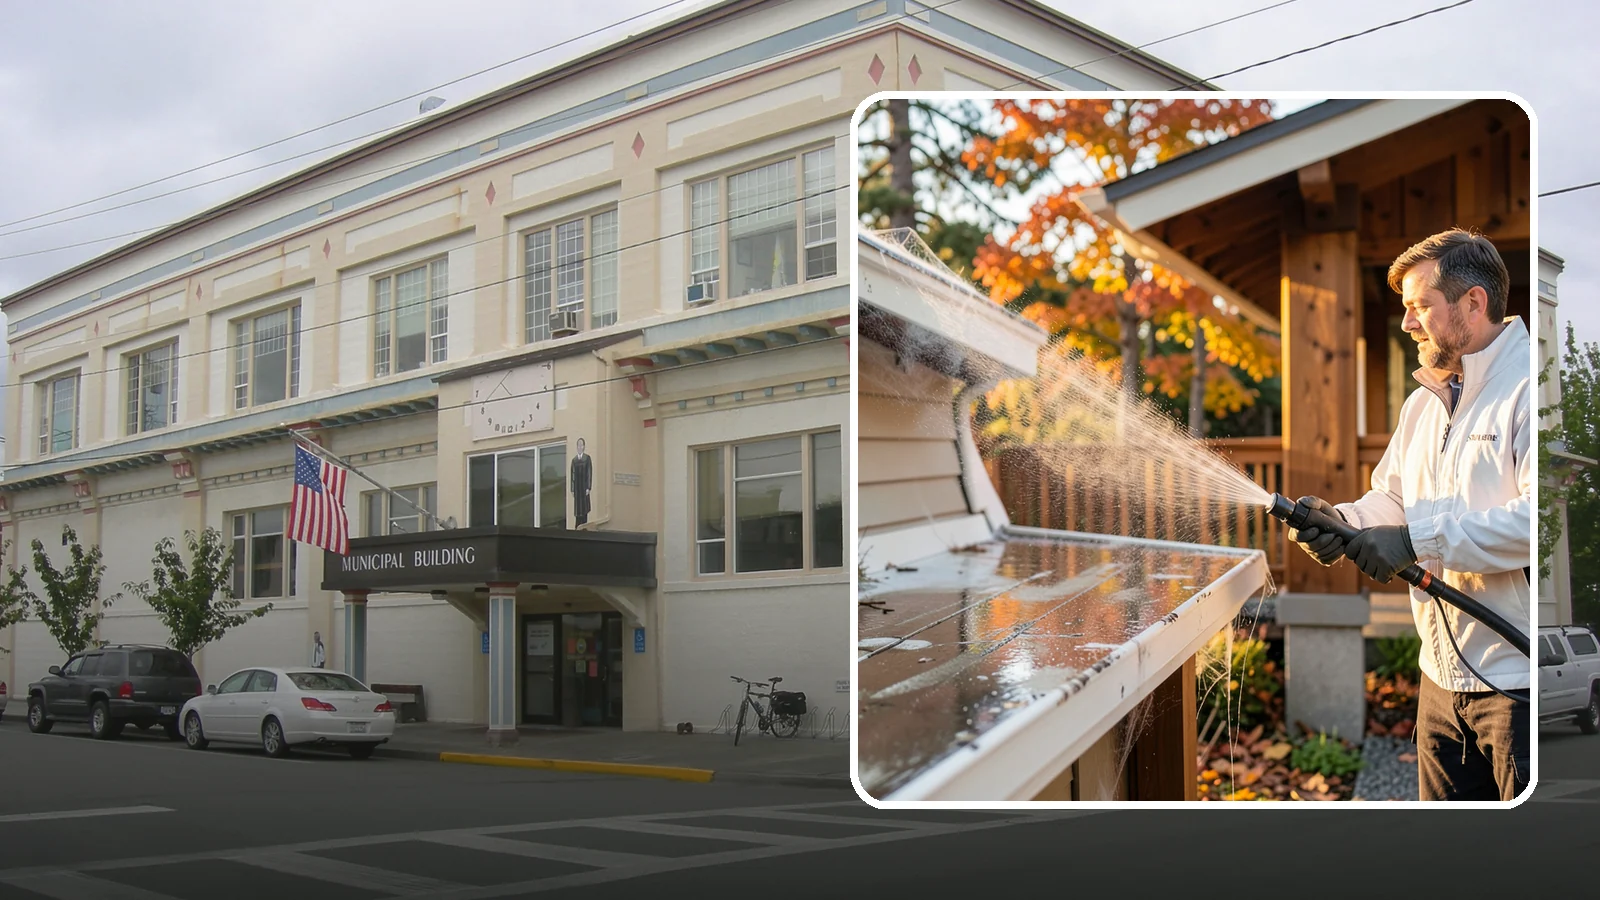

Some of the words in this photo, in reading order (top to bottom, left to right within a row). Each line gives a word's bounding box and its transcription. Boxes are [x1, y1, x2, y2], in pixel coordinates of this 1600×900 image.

[546, 362, 552, 370] 6
[475, 390, 479, 398] 7
[481, 406, 485, 415] 8
[488, 418, 492, 426] 9
[529, 414, 533, 422] 3
[495, 424, 500, 432] 10
[521, 420, 526, 429] 2
[507, 426, 513, 434] 12
[342, 552, 405, 572] MUNICIPAL
[414, 546, 475, 567] BUILDING
